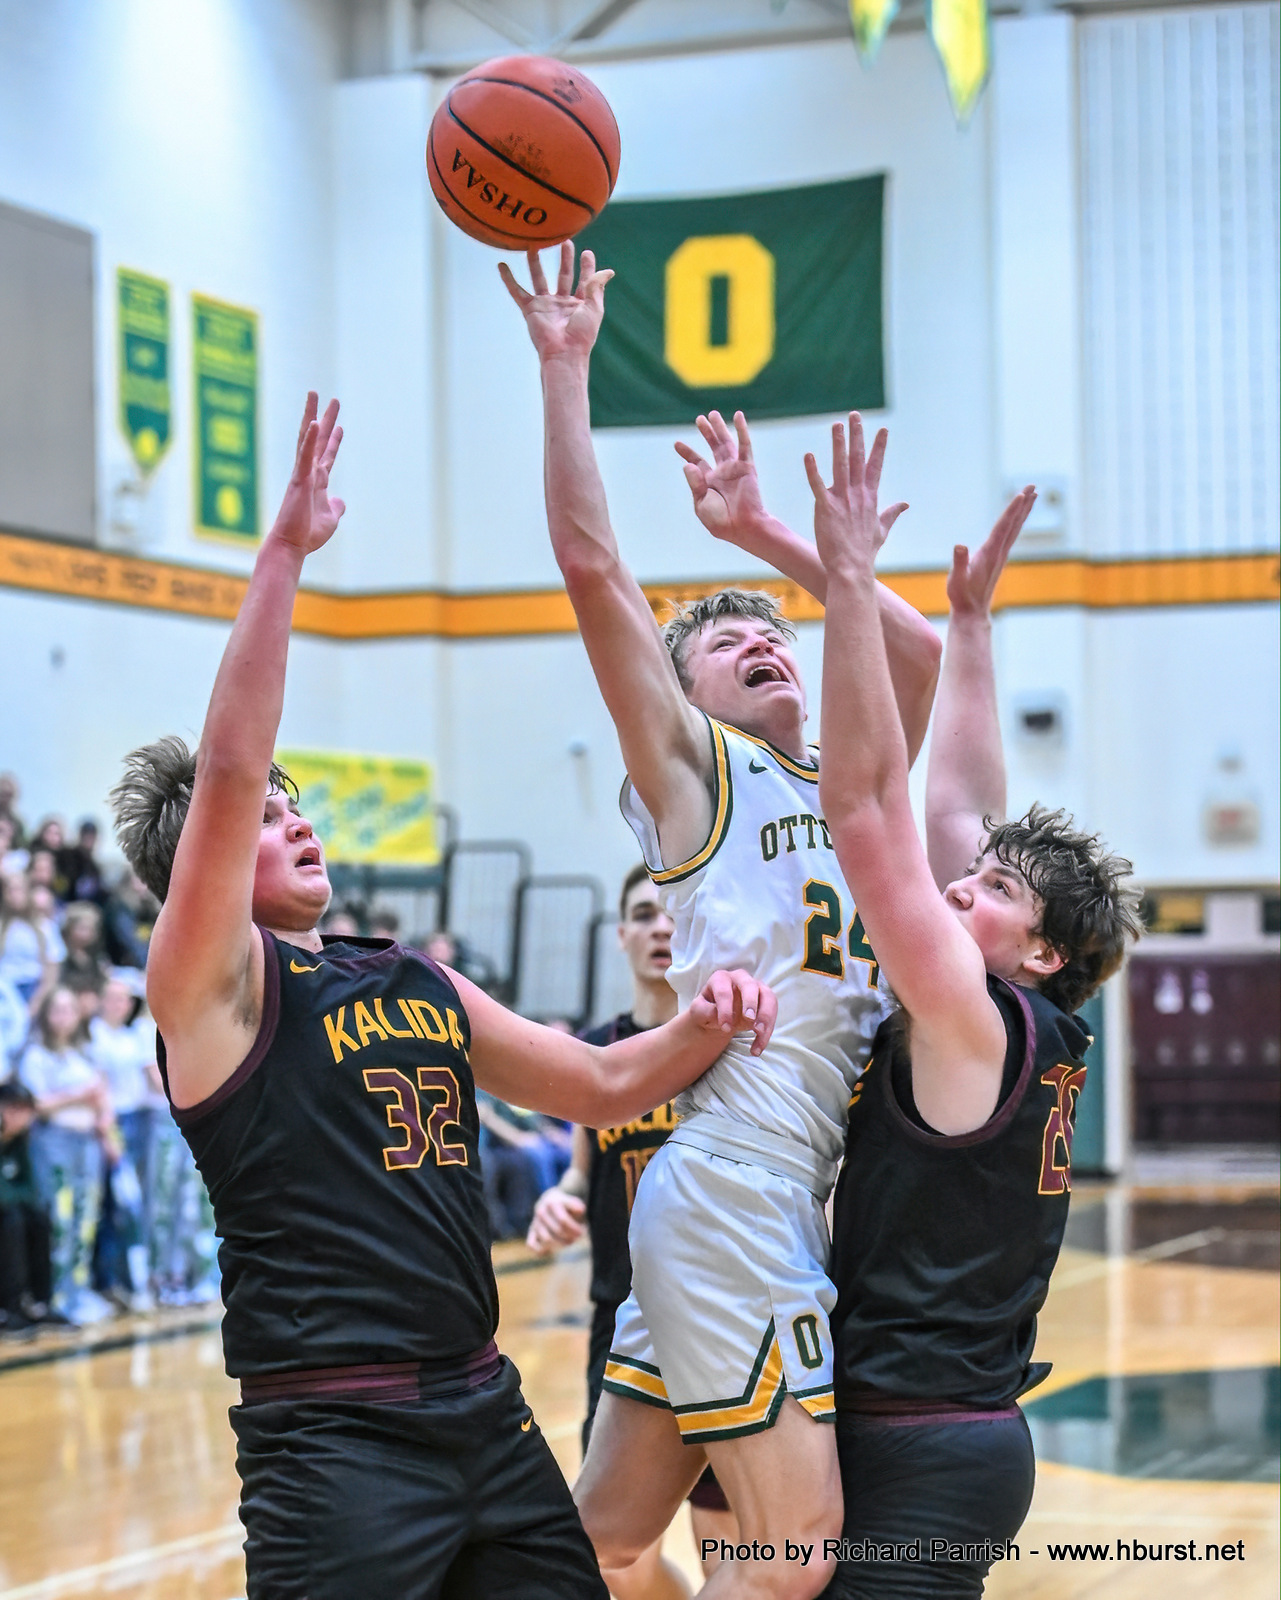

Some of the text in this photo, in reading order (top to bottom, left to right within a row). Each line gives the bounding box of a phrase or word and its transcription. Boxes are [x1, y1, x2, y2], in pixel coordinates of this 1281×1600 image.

[451, 148, 548, 226] OHSAA
[664, 232, 776, 390] O
[323, 997, 470, 1065] KALIDA
[362, 1066, 469, 1172] 32
[792, 1313, 825, 1371] O
